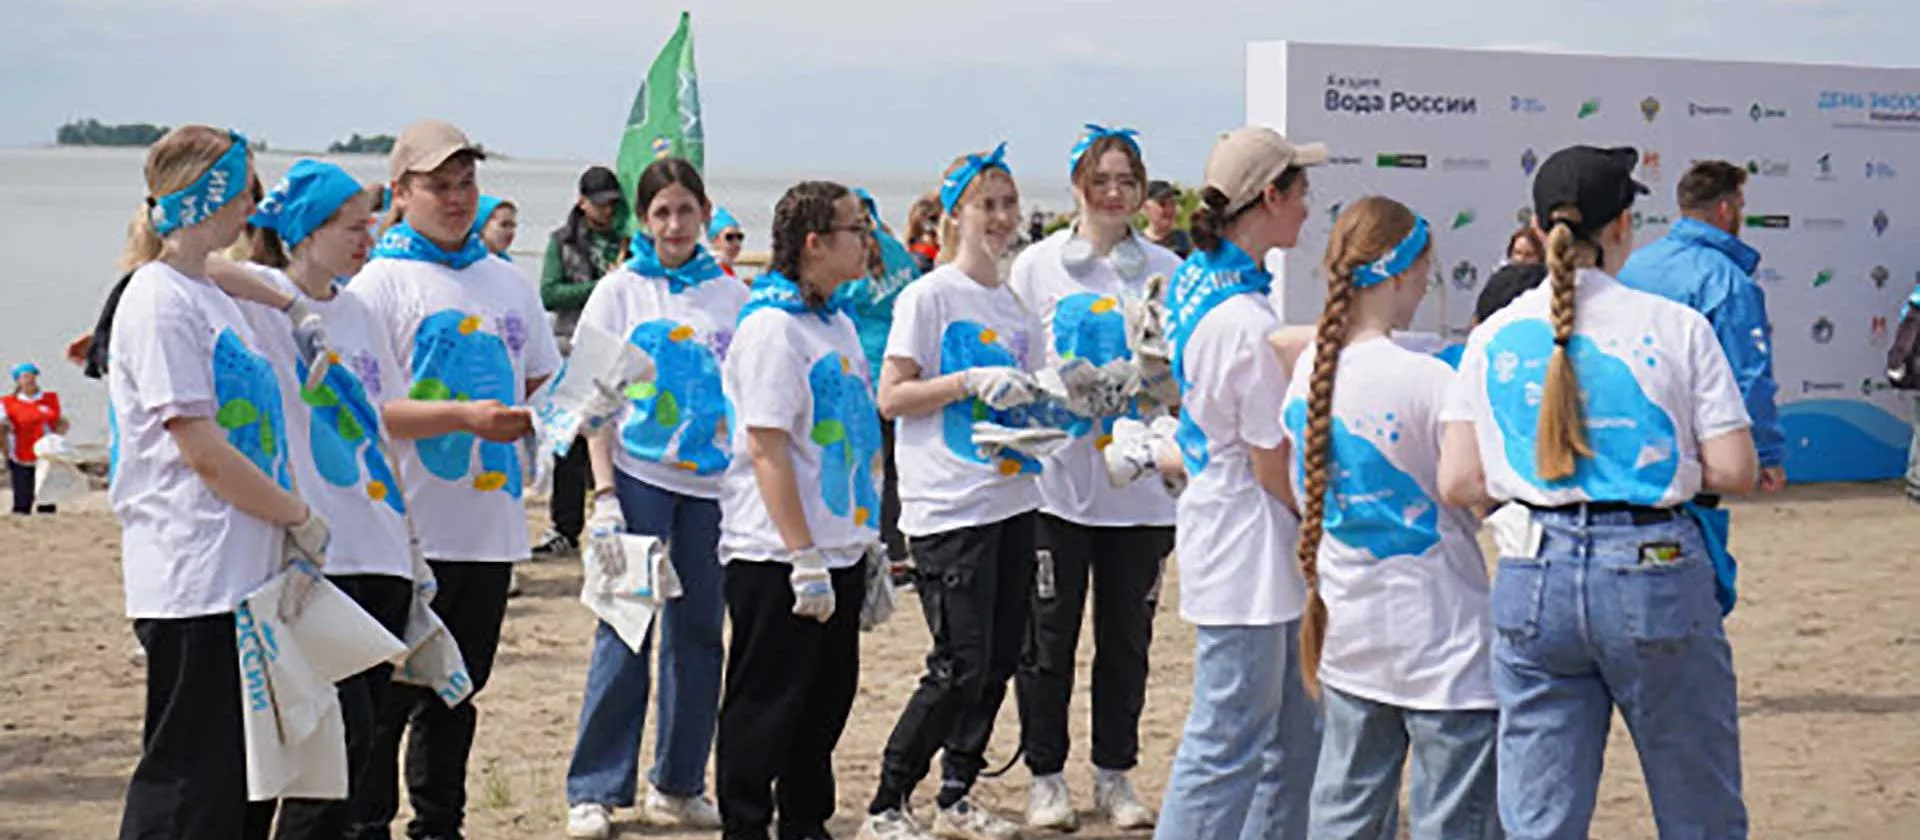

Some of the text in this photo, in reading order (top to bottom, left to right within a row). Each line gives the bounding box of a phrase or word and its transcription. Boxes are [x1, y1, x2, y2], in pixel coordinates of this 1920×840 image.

[1325, 89, 1477, 113] Вода России
[236, 600, 268, 712] ОССИИ
